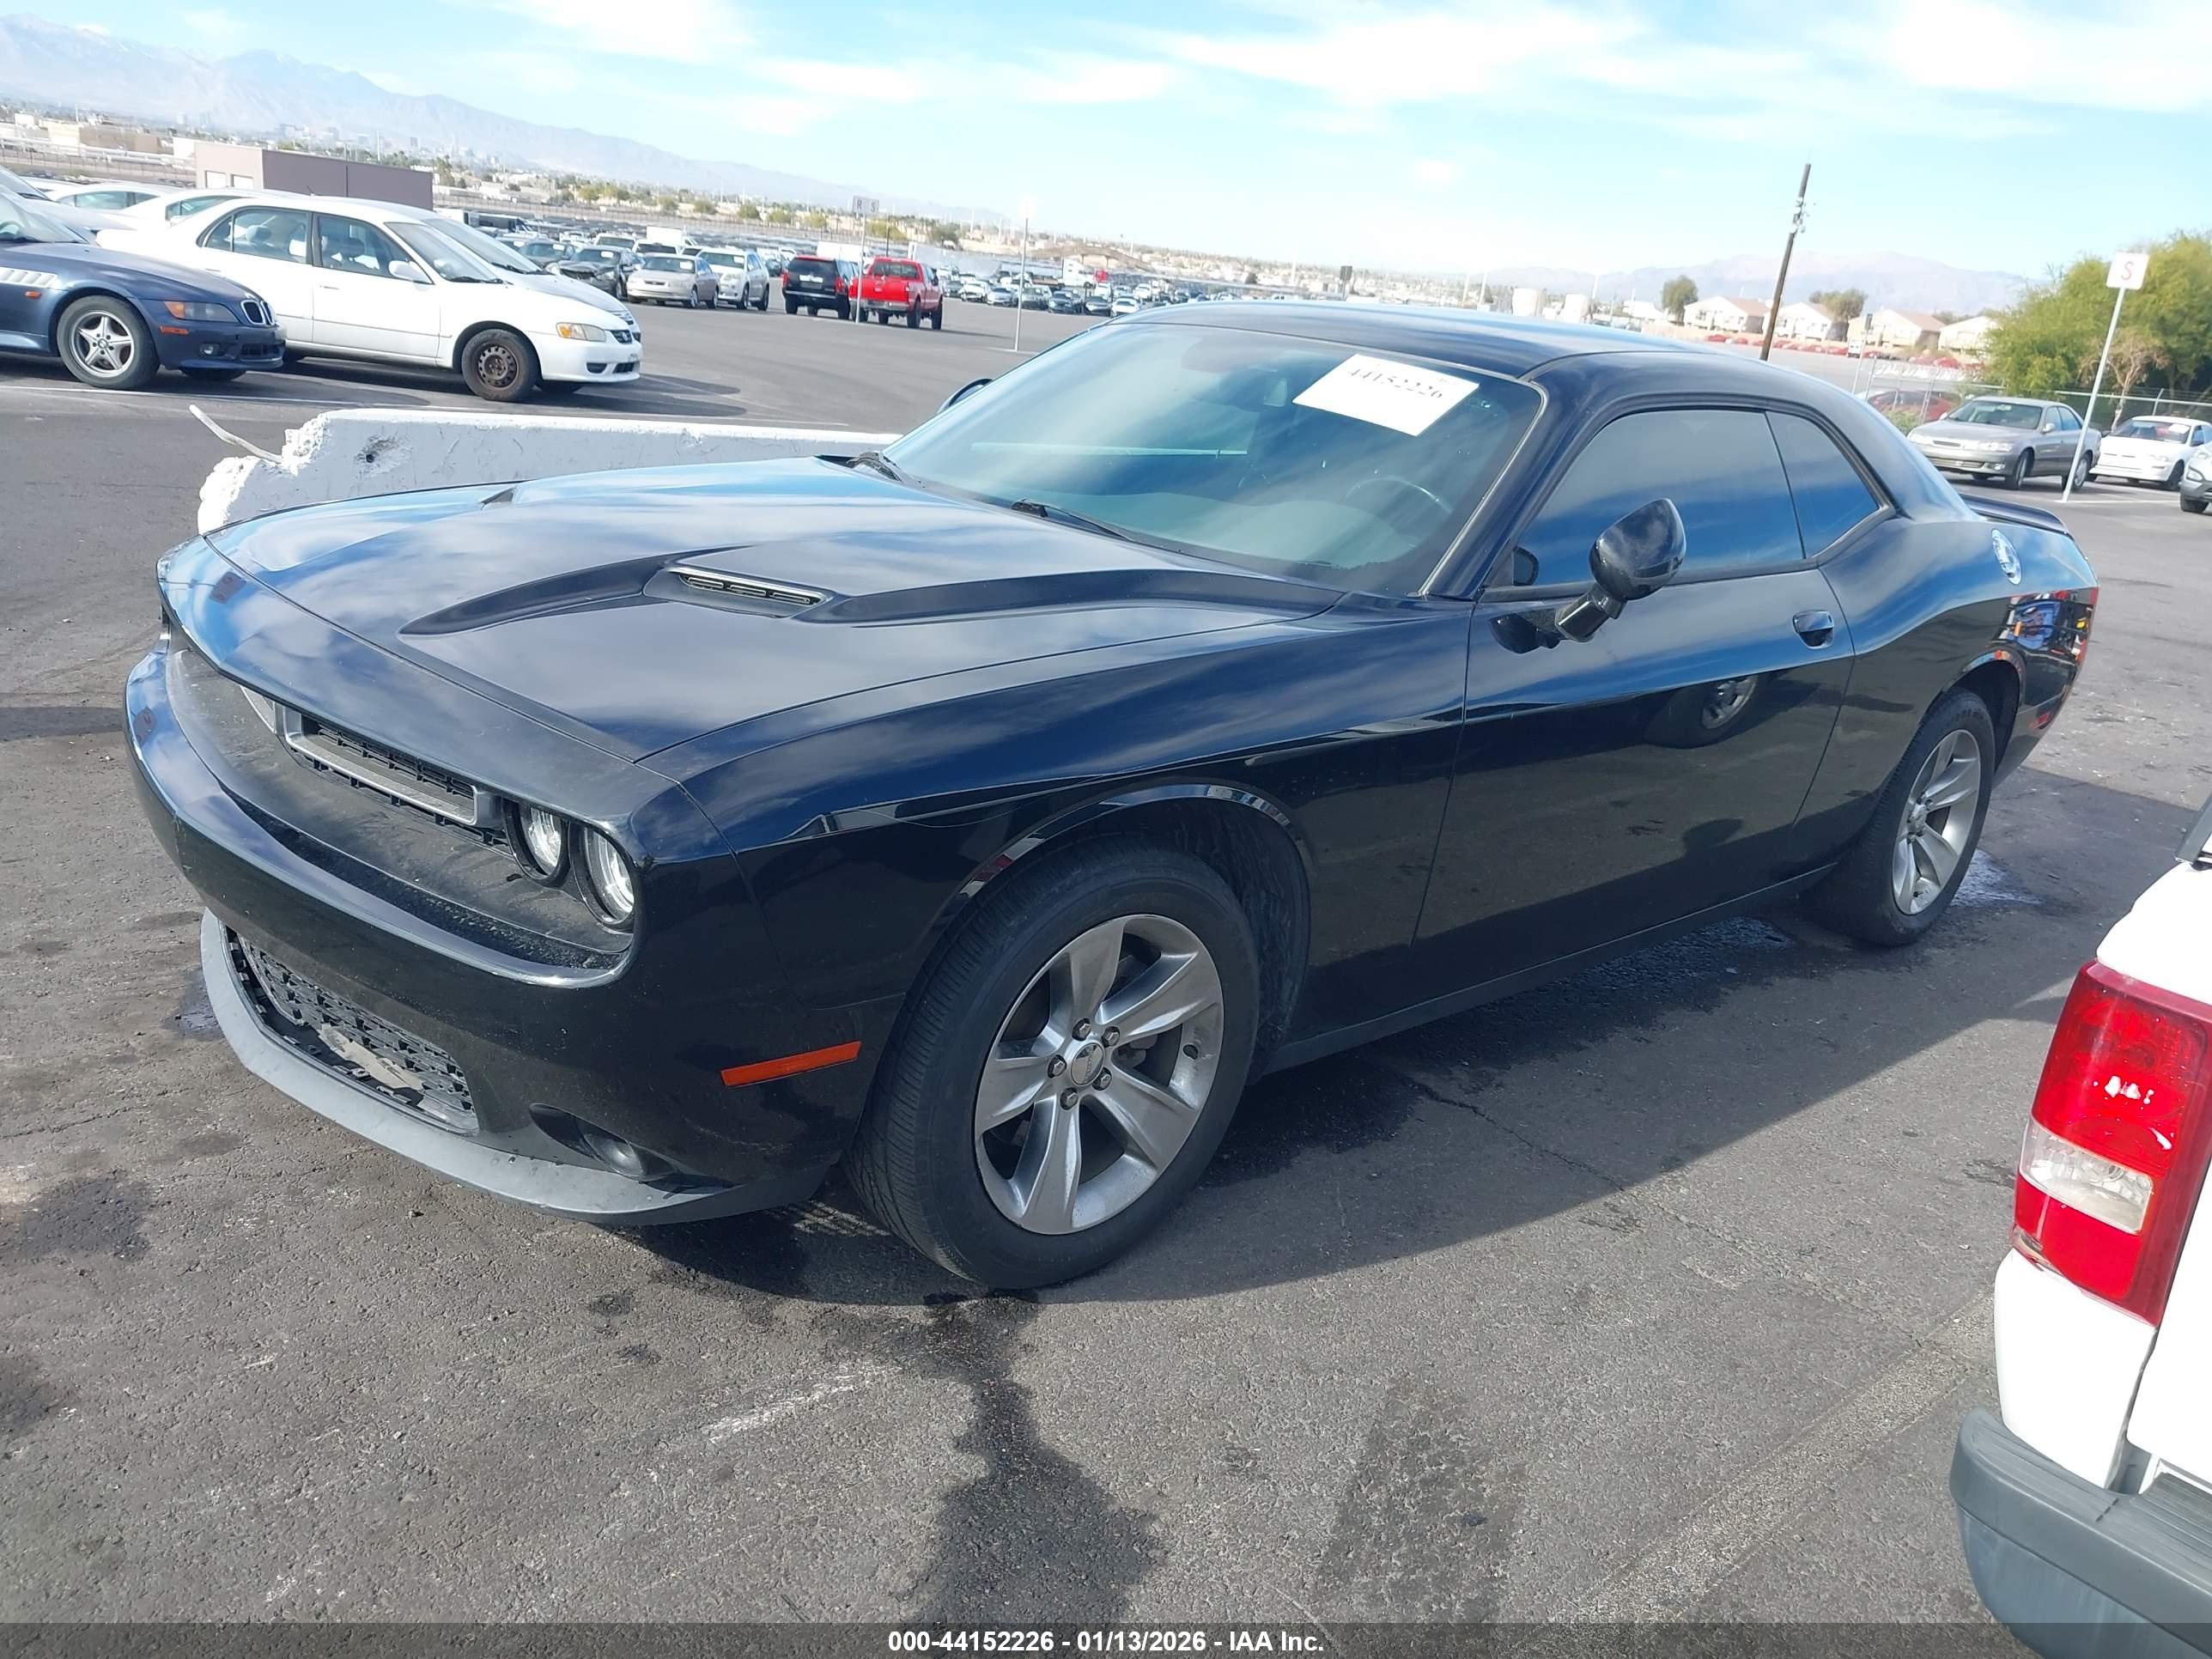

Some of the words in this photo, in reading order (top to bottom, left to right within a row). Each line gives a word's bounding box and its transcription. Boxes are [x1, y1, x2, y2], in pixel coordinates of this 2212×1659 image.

[856, 199, 862, 210] R
[871, 201, 877, 212] S
[2121, 260, 2135, 281] S
